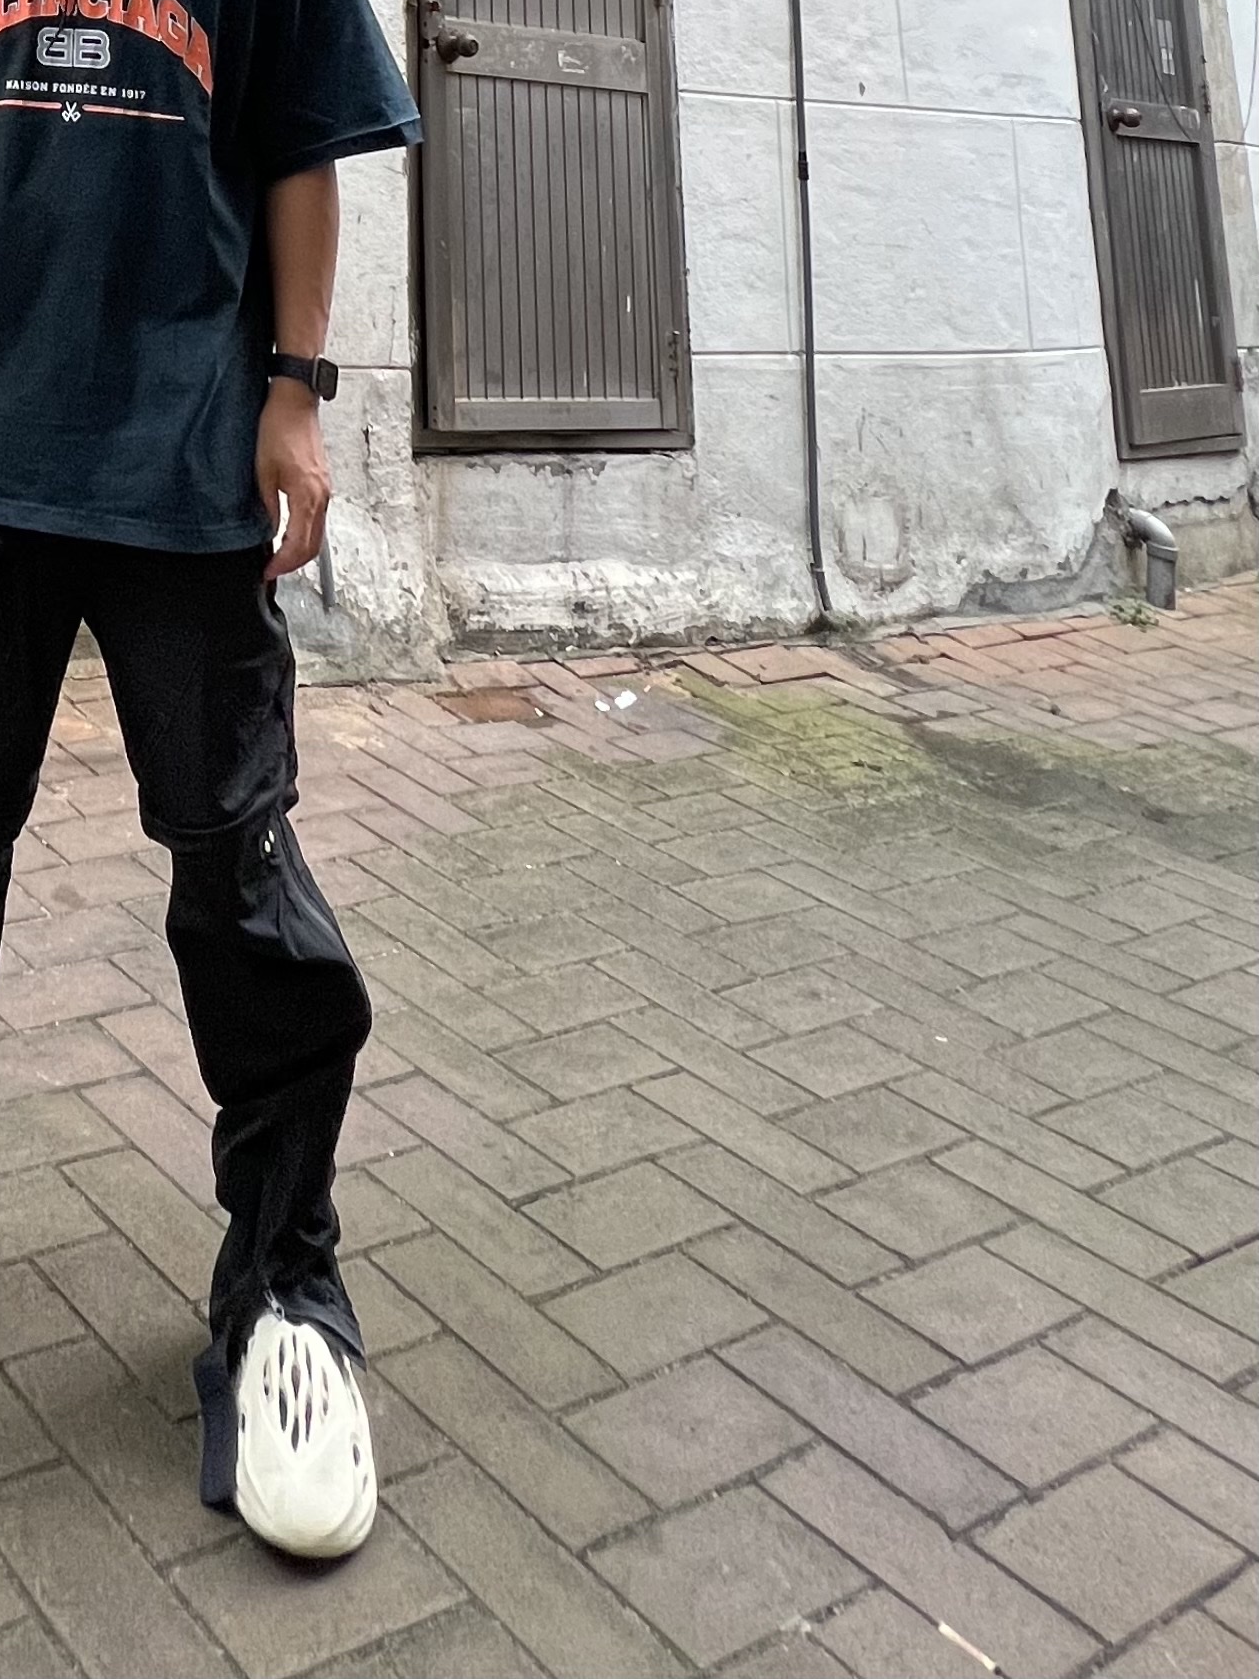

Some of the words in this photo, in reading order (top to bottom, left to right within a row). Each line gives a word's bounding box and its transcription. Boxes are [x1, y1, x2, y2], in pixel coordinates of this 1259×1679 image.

[5, 79, 49, 92] MAISON
[100, 86, 117, 97] EN
[121, 88, 146, 100] 1917
